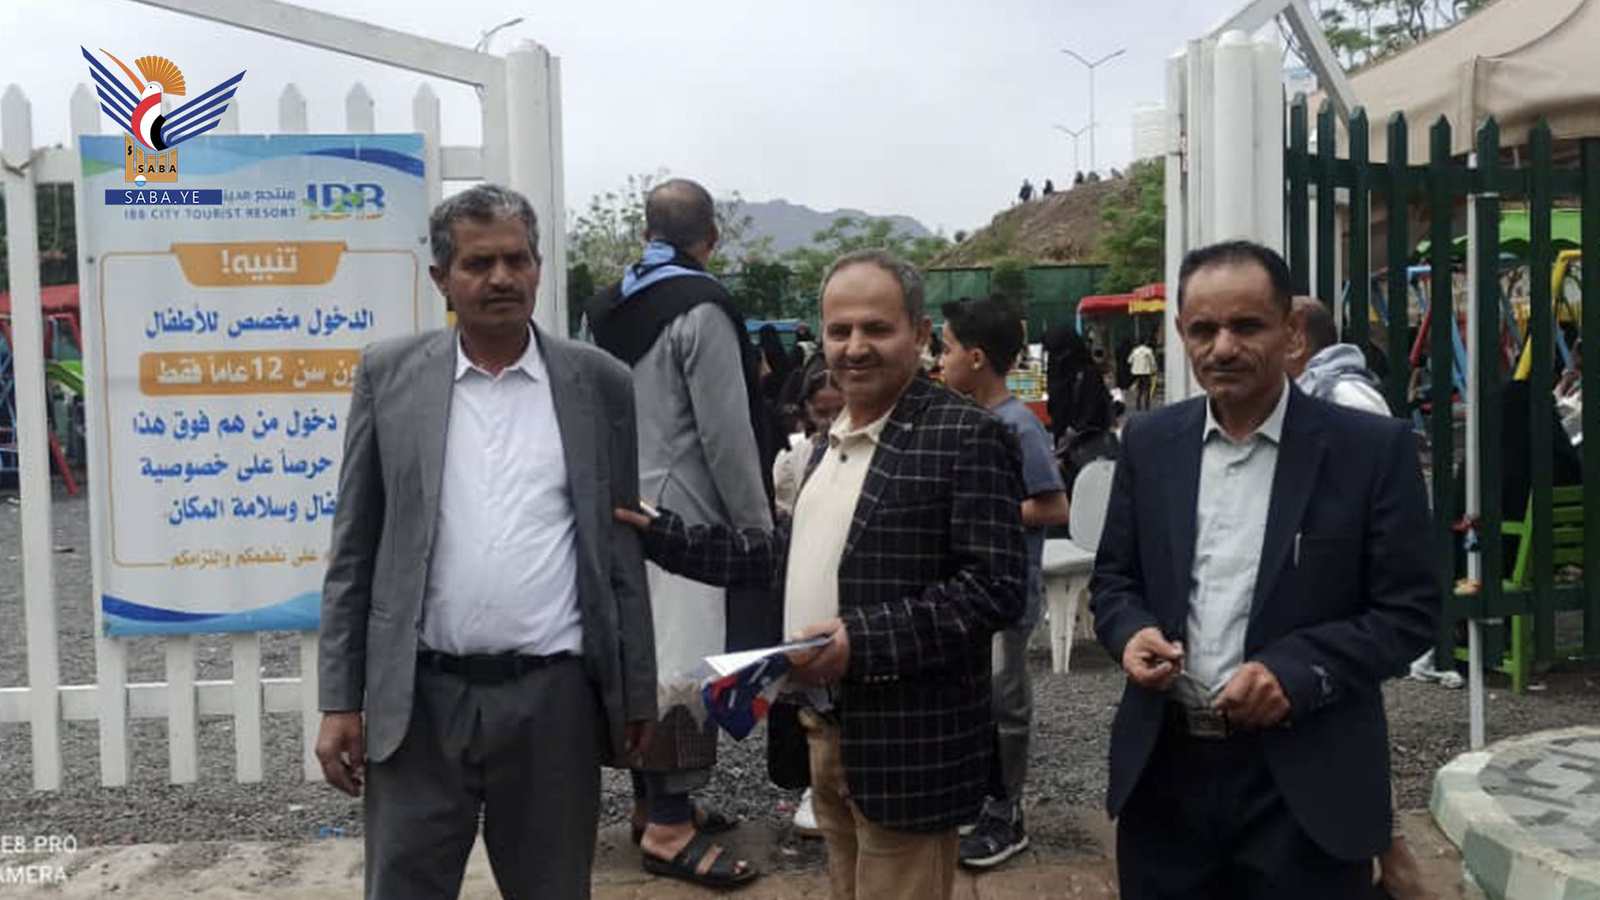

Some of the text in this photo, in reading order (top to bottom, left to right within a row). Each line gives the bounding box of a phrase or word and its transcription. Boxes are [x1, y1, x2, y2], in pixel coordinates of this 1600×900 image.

[151, 208, 179, 220] CITY
[185, 208, 240, 219] TOURIST
[246, 207, 296, 219] RESORT
[221, 247, 297, 281] تنبيه!
[145, 304, 373, 339] الدخول مخصص للأطفال
[156, 358, 202, 384] فقط
[252, 356, 283, 380] 12
[291, 358, 326, 388] سن
[133, 408, 337, 440] دخول من هم فوق هذا
[141, 453, 228, 483] خصوصية
[237, 454, 273, 482] على
[169, 495, 224, 525] المكان
[231, 494, 298, 522] وسلامة
